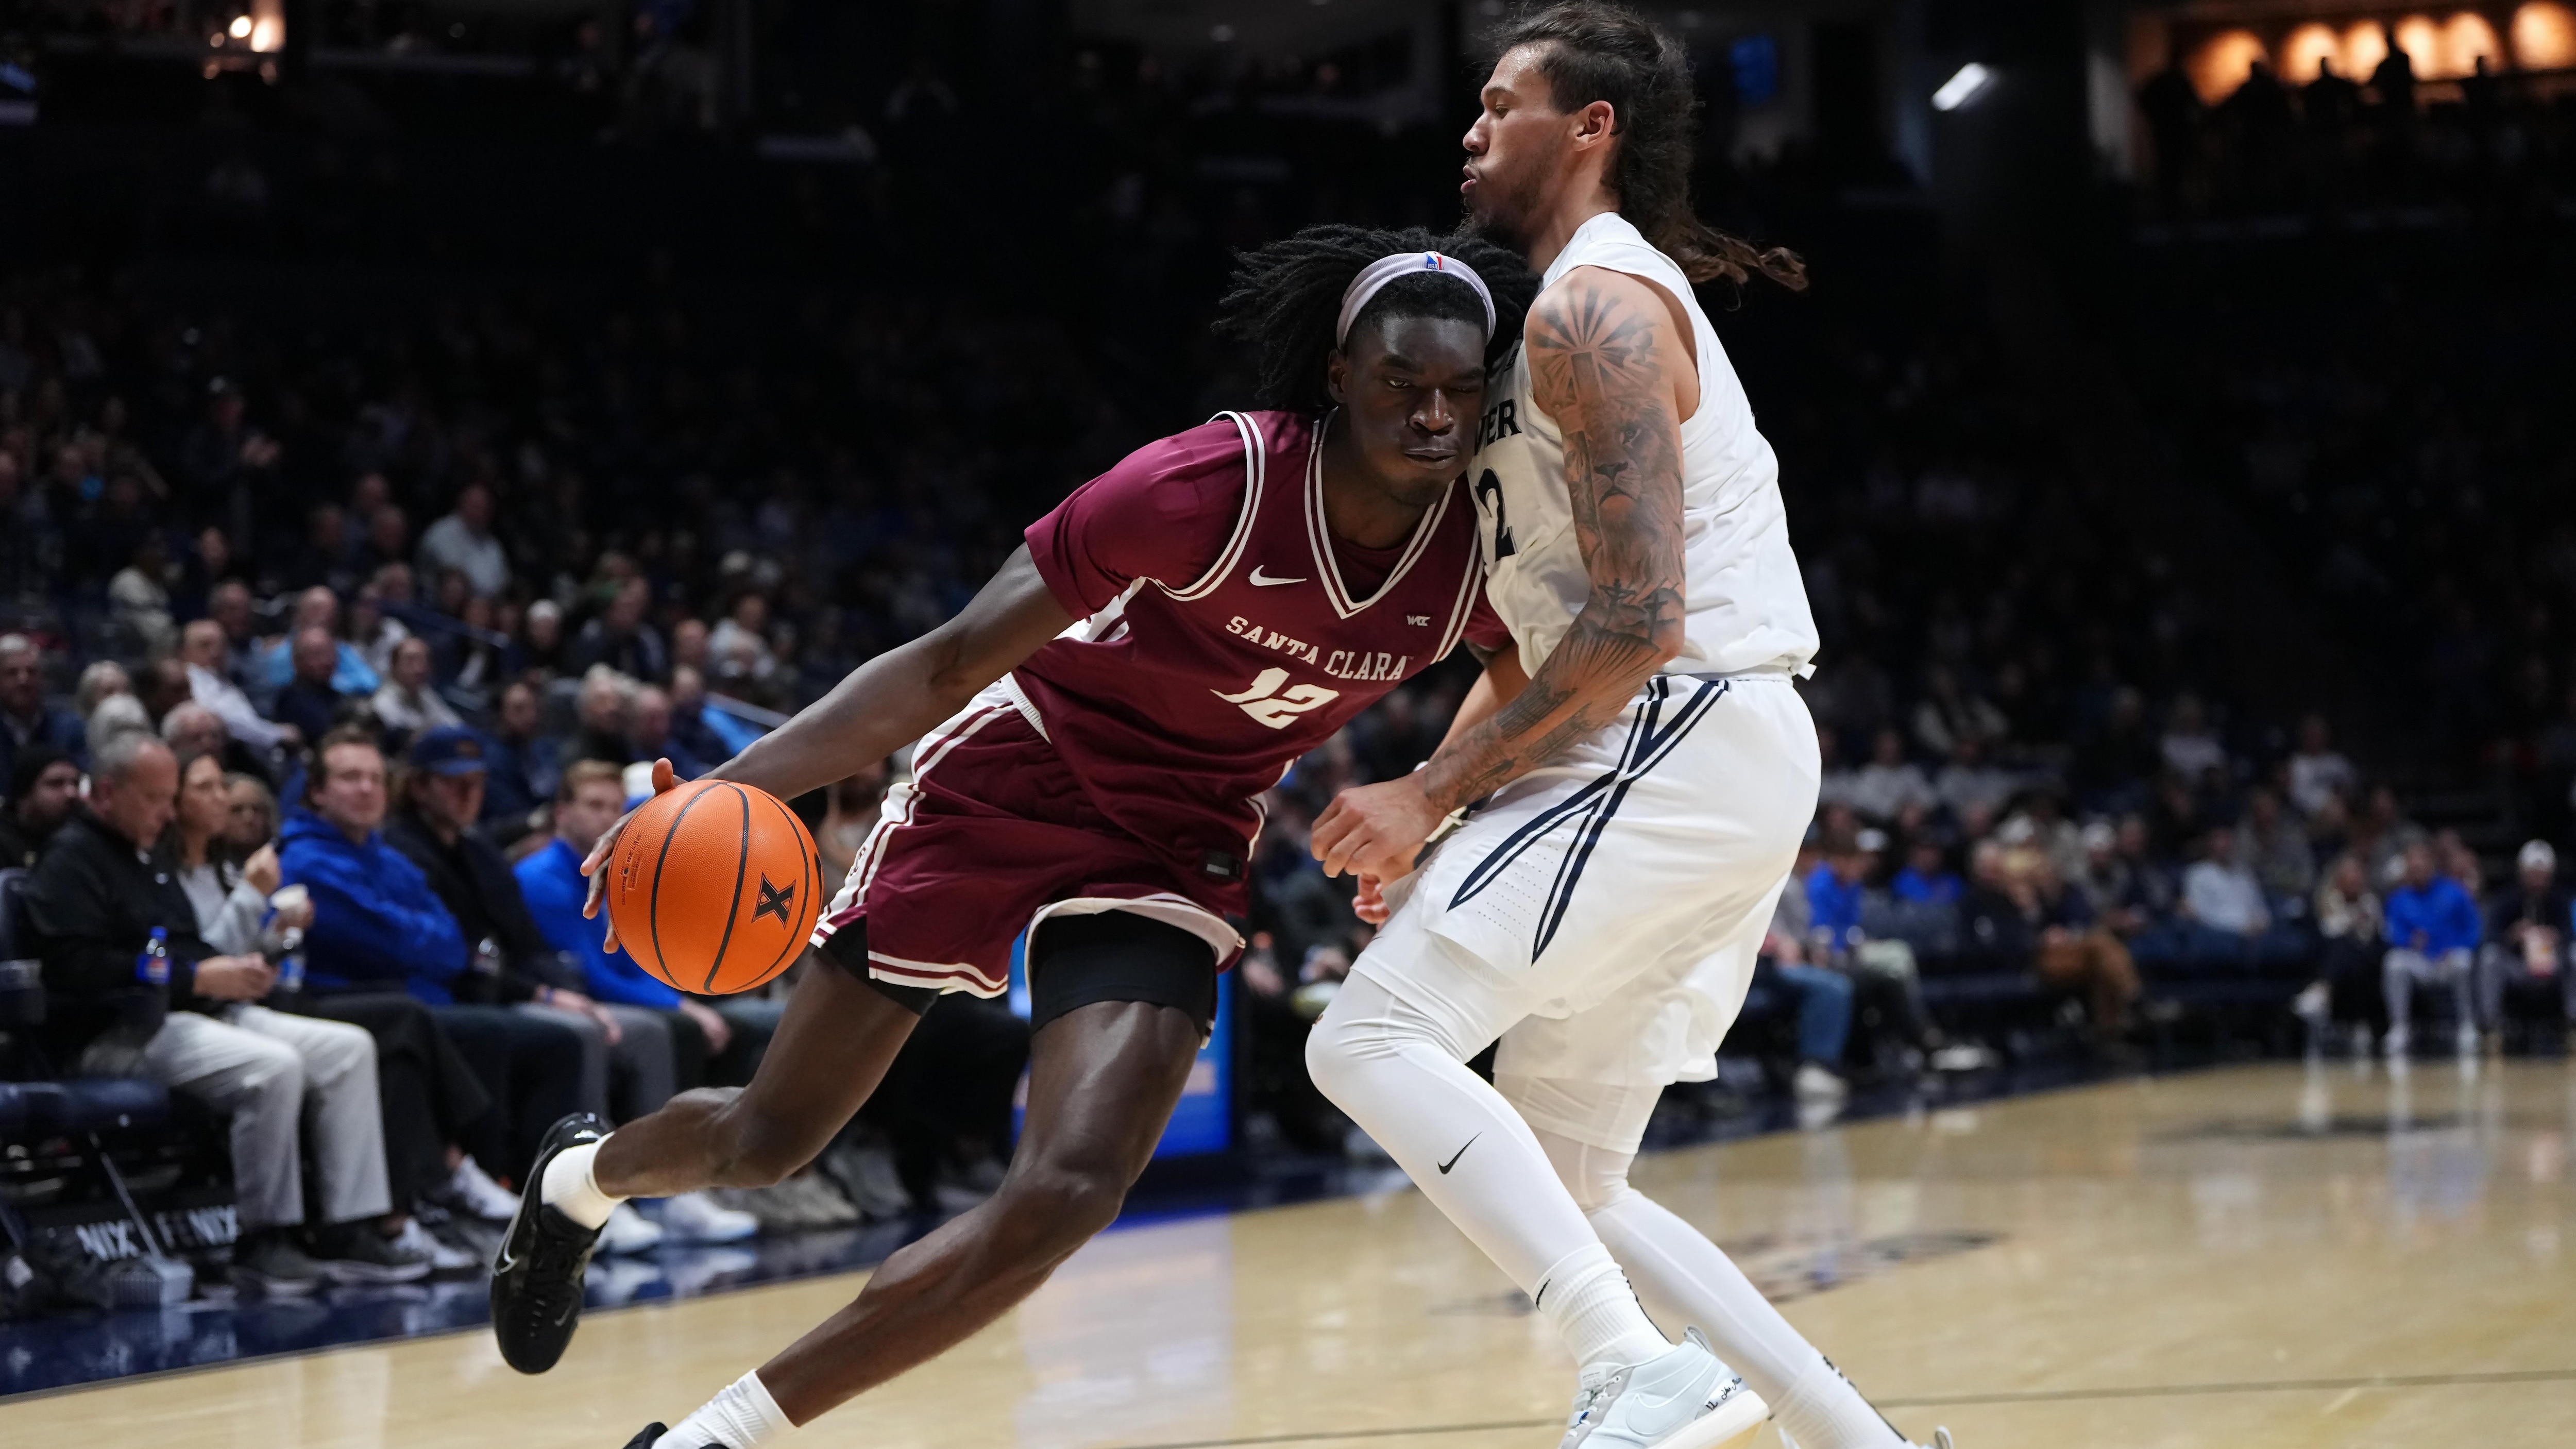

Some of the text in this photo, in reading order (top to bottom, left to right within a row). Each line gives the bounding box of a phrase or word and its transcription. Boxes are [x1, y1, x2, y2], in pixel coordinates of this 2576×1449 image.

[1225, 616, 1407, 681] SANTA CLARA
[1209, 667, 1340, 730] 12
[76, 1219, 140, 1261] NIX
